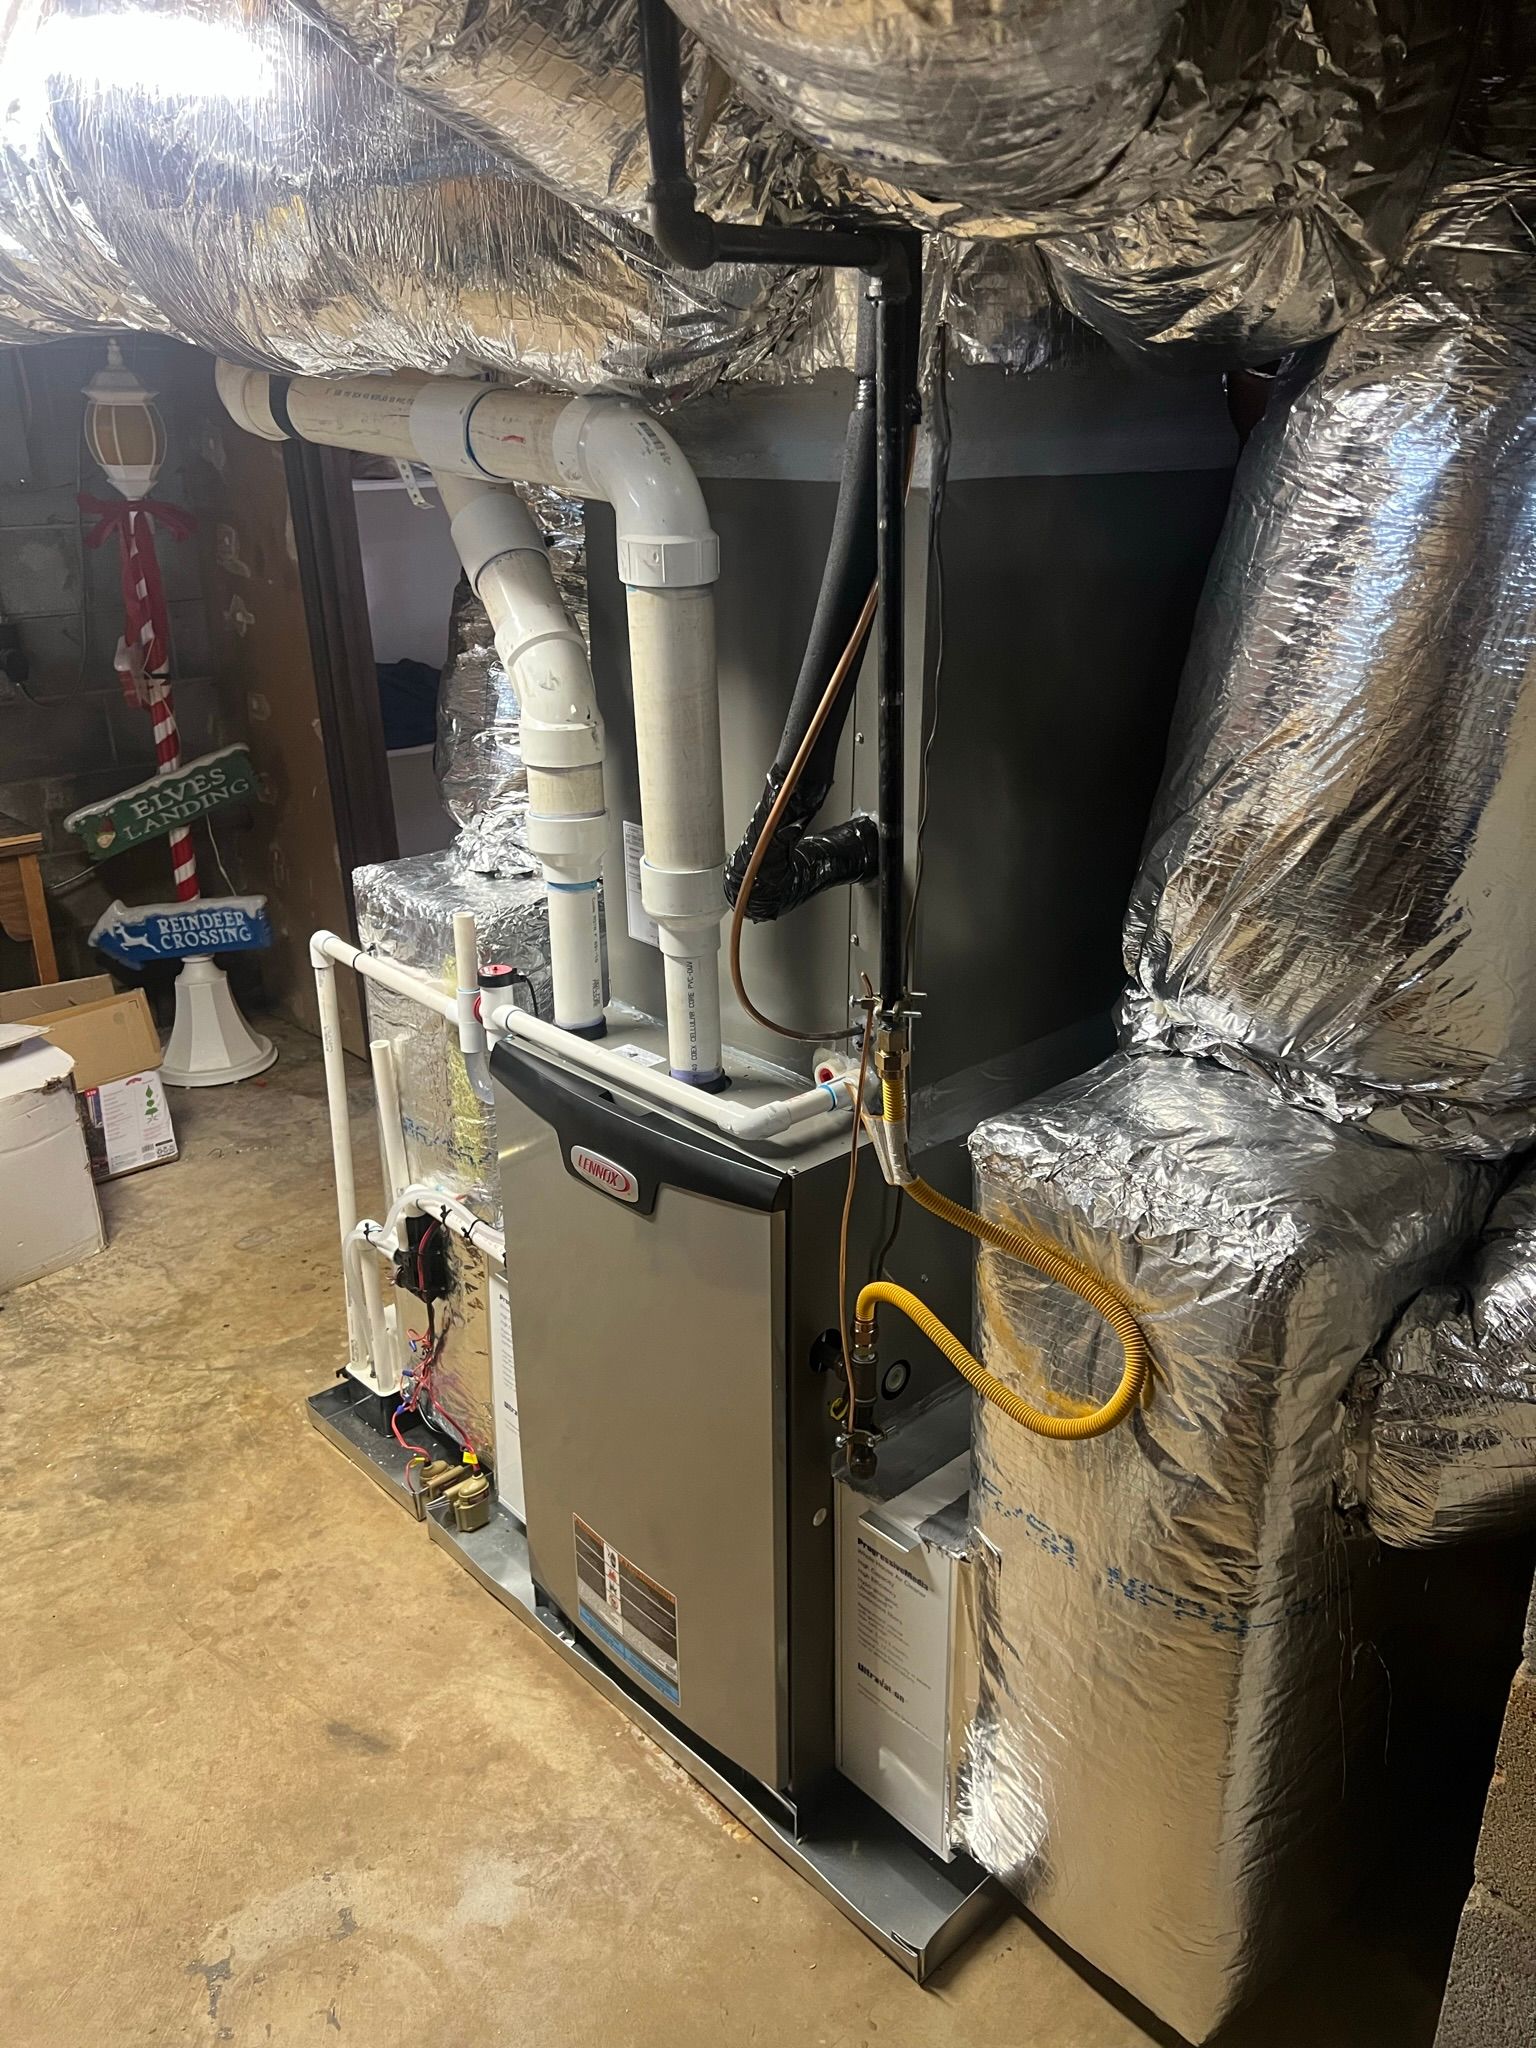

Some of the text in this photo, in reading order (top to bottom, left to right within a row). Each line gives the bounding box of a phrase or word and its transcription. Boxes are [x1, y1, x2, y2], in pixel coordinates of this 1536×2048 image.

[130, 768, 226, 819] ELVES
[123, 779, 249, 841] LANDING
[157, 911, 246, 934] REINDEER
[160, 927, 251, 950] CROSSING
[687, 992, 695, 1008] CORE
[688, 1011, 697, 1042] CELLULAR
[578, 1154, 619, 1187] LENNOX
